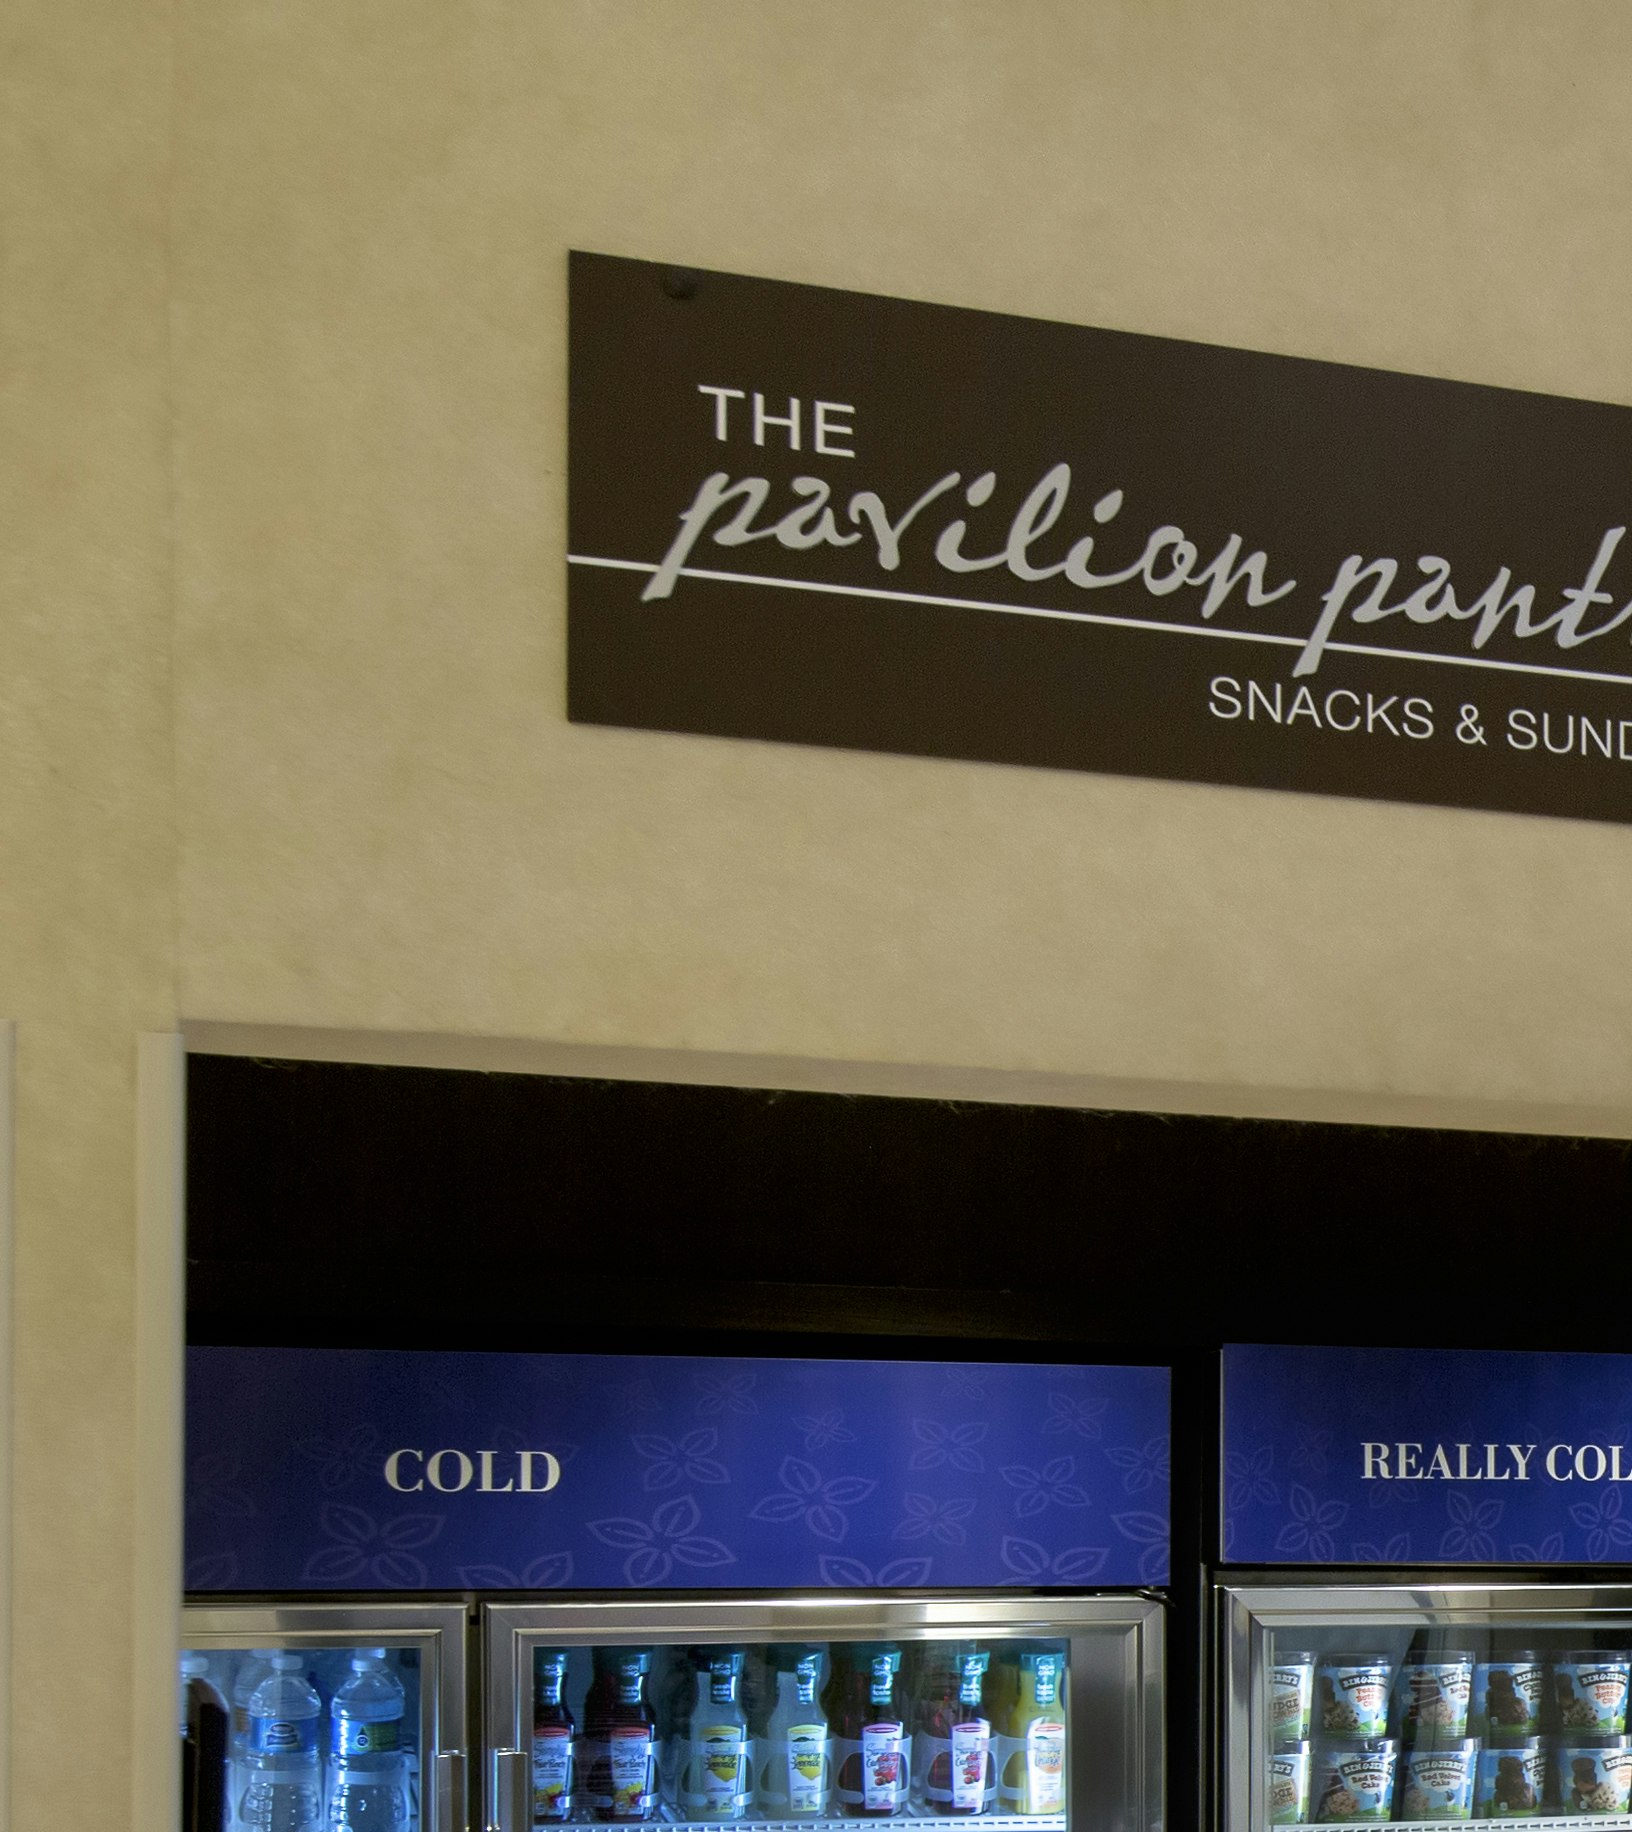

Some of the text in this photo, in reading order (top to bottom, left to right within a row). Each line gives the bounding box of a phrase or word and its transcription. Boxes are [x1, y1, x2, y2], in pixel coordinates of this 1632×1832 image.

[697, 384, 857, 458] THE
[640, 462, 1298, 618] pavilion
[1208, 676, 1437, 743] SNACKS
[1455, 702, 1488, 746] &
[384, 1449, 561, 1492] COLD
[1360, 1442, 1537, 1480] REALLY
